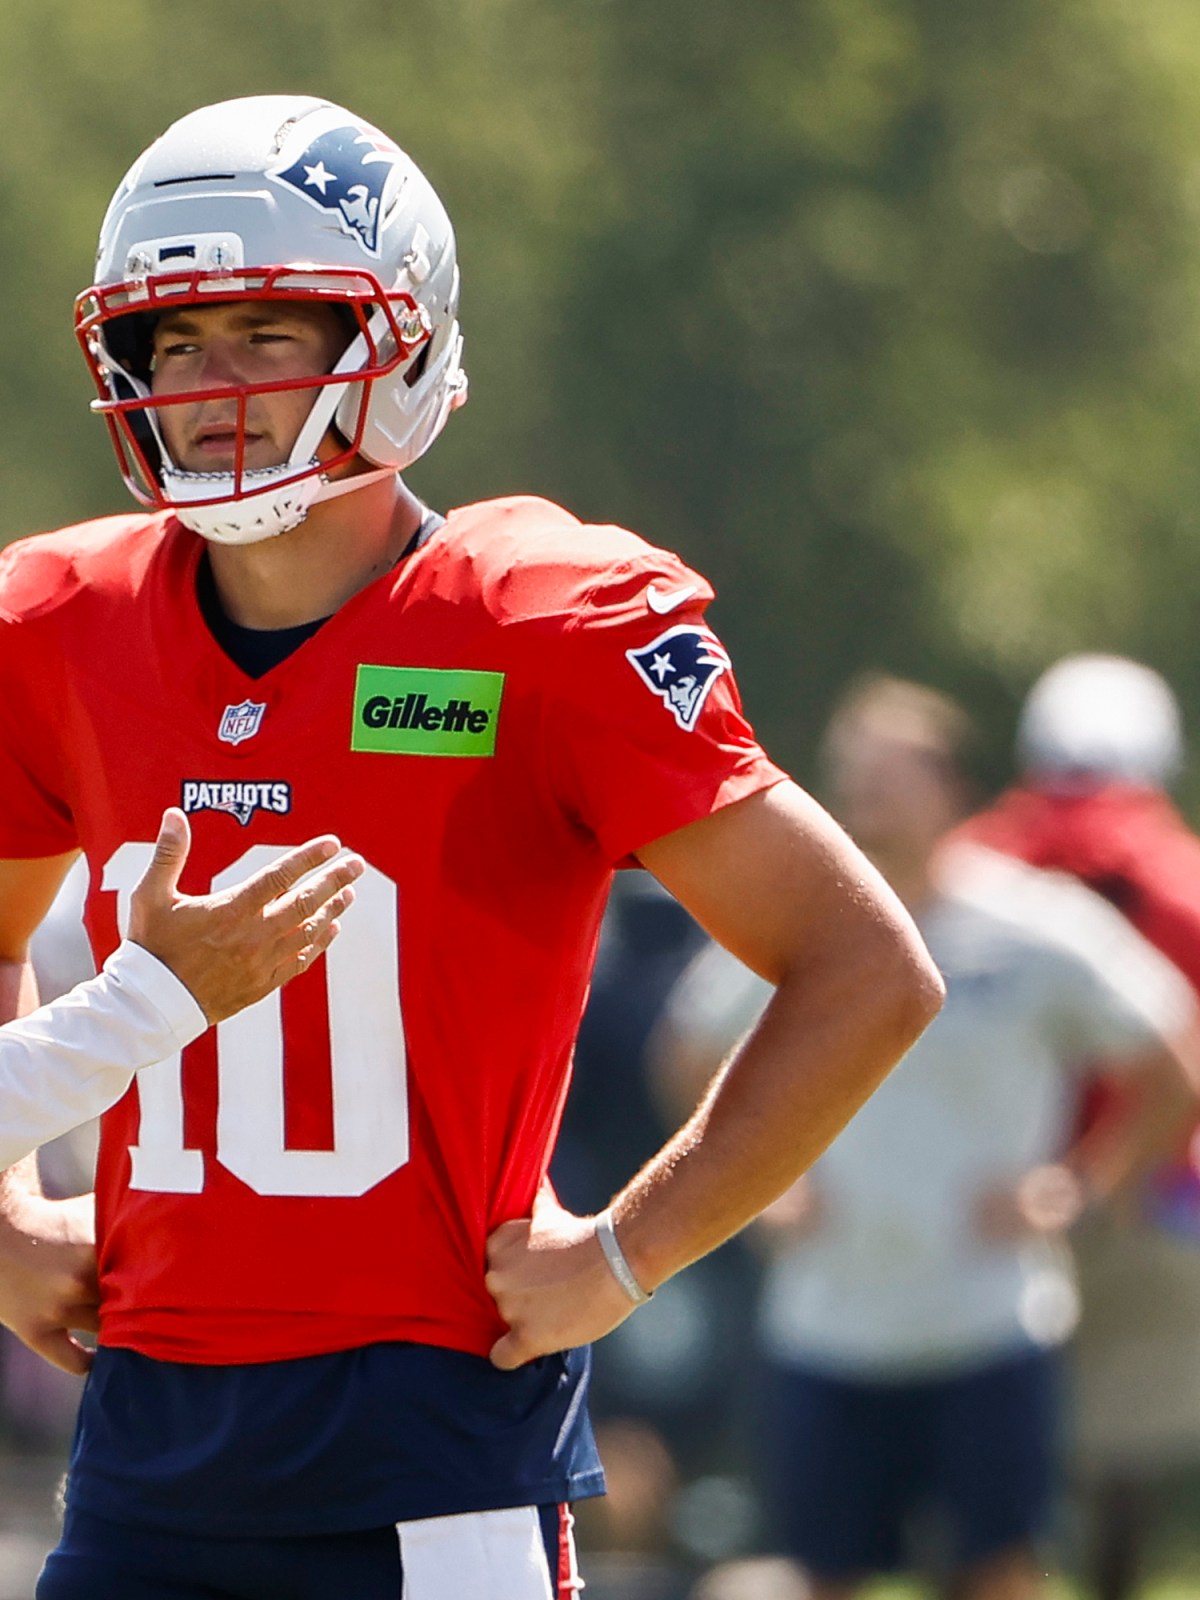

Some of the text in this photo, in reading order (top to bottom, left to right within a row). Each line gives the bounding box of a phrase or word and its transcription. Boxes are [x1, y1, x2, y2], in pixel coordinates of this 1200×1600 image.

[225, 716, 252, 735] NFL
[362, 693, 489, 734] Gillette
[183, 782, 289, 813] PATRIOTS
[100, 841, 411, 1198] 10
